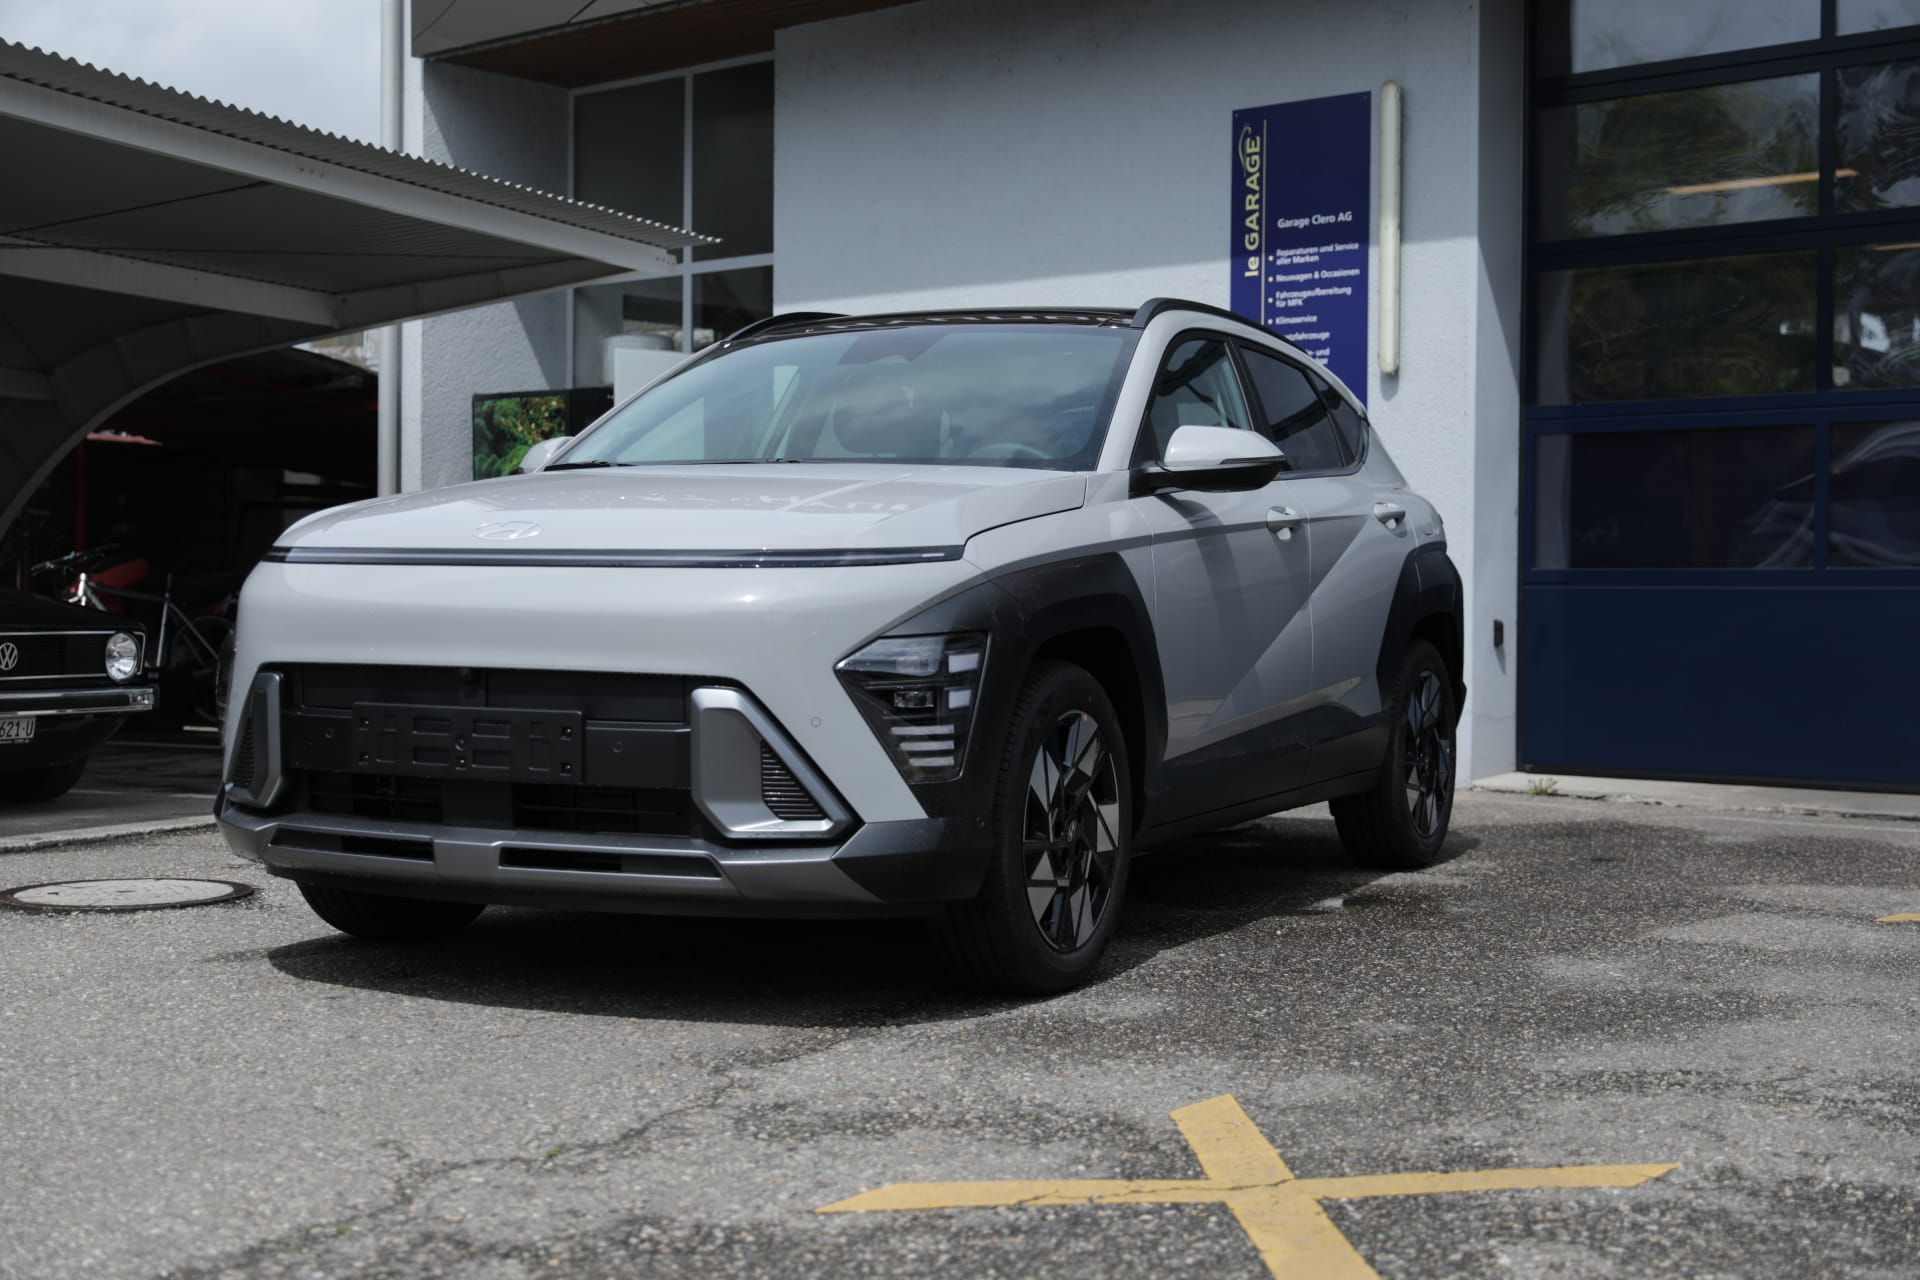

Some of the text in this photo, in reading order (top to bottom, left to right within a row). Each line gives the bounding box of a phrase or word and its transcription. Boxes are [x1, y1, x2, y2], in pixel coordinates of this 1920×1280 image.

[1244, 136, 1260, 277] le GARAGE
[1277, 211, 1353, 229] Garage Clero AG
[1276, 242, 1360, 257] Reparaturen und Service
[1276, 254, 1319, 266] aller Marken
[1275, 268, 1361, 283] Neuwagen & Occasionen
[1275, 315, 1318, 325] Klimaservice
